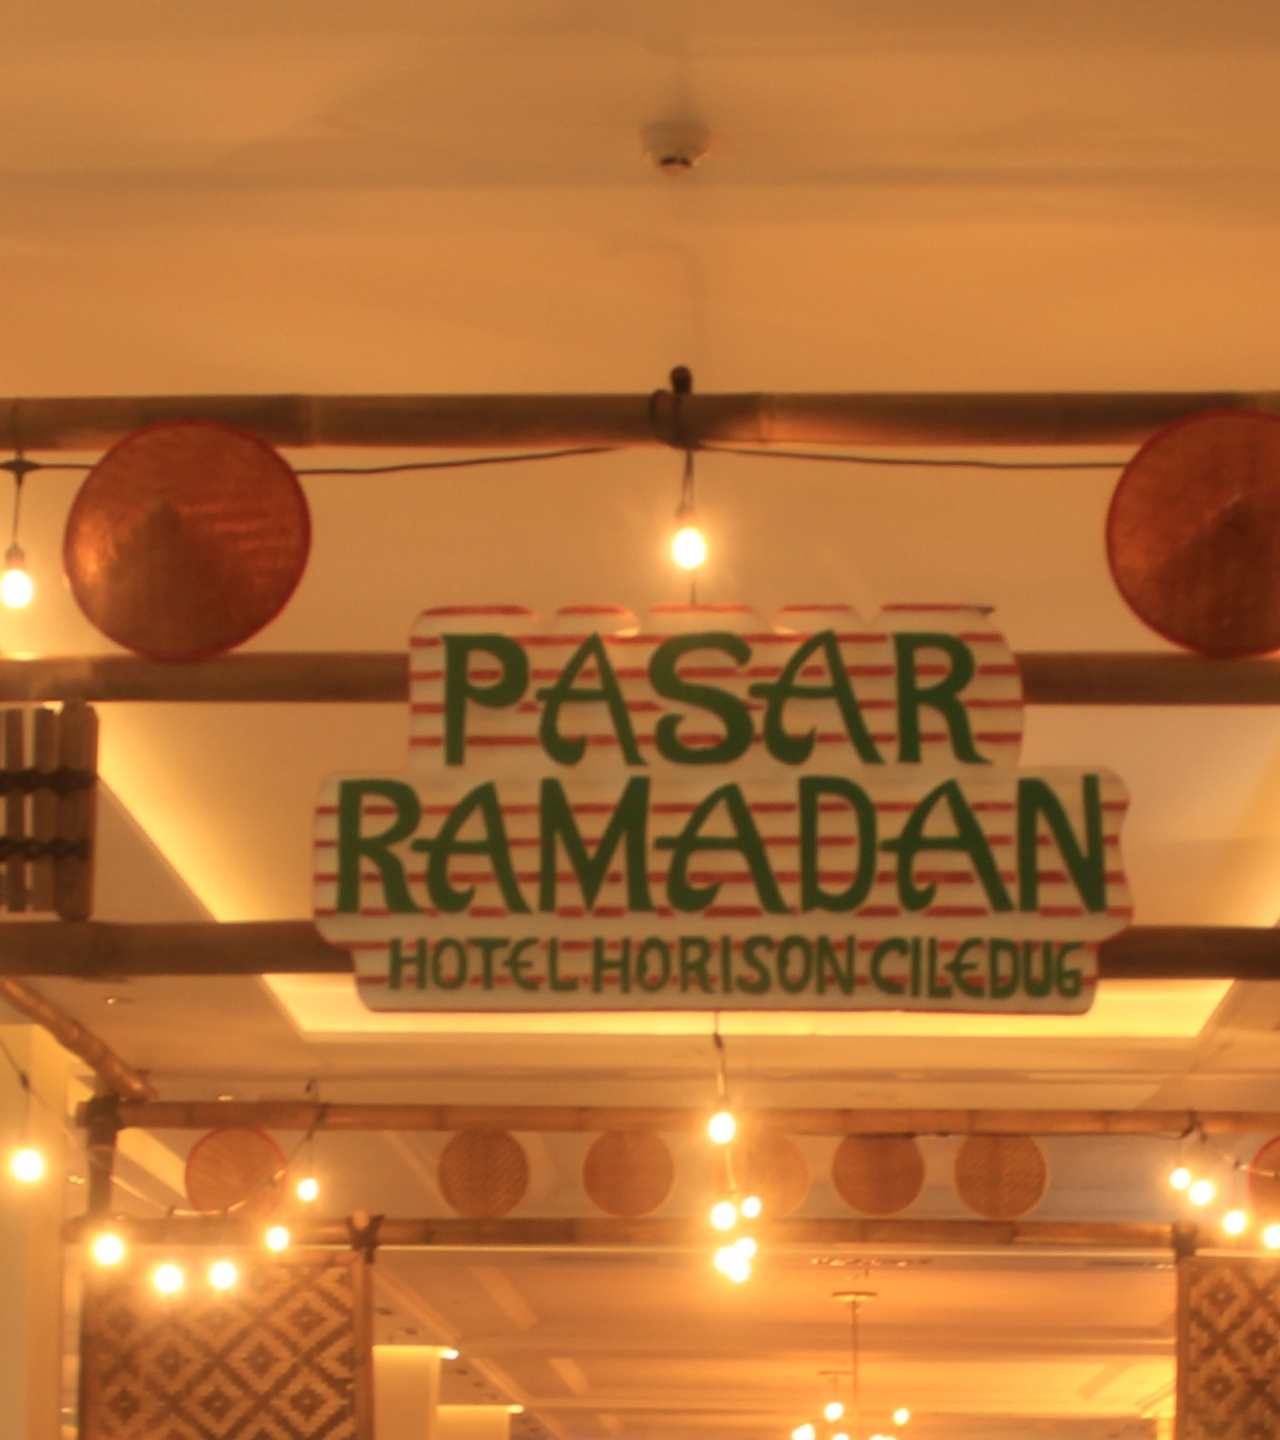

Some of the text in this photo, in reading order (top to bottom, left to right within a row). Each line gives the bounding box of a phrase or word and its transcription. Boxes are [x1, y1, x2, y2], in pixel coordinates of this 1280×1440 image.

[439, 630, 995, 767] PASAR
[334, 774, 1109, 915] RAMADAN
[387, 935, 1084, 999] HOTEL HORISON CILEDUG
